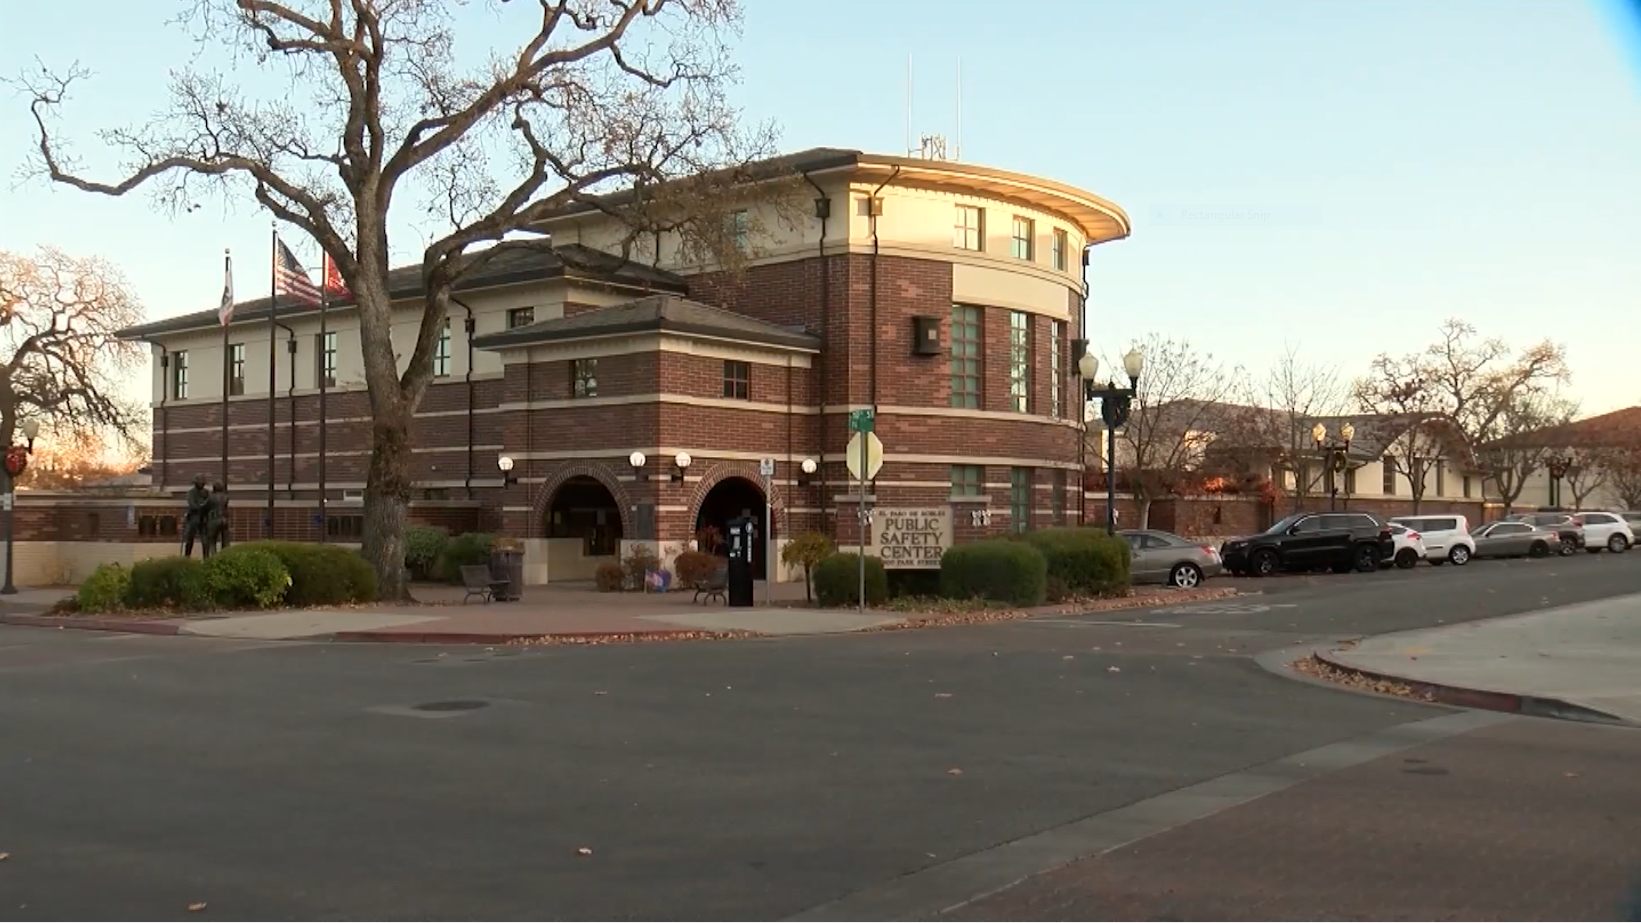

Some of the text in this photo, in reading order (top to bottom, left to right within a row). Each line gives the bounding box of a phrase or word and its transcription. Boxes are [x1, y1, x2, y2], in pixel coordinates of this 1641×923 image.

[885, 518, 940, 531] PUBLIC
[880, 532, 944, 545] SAFETY
[880, 546, 943, 559] CENTER
